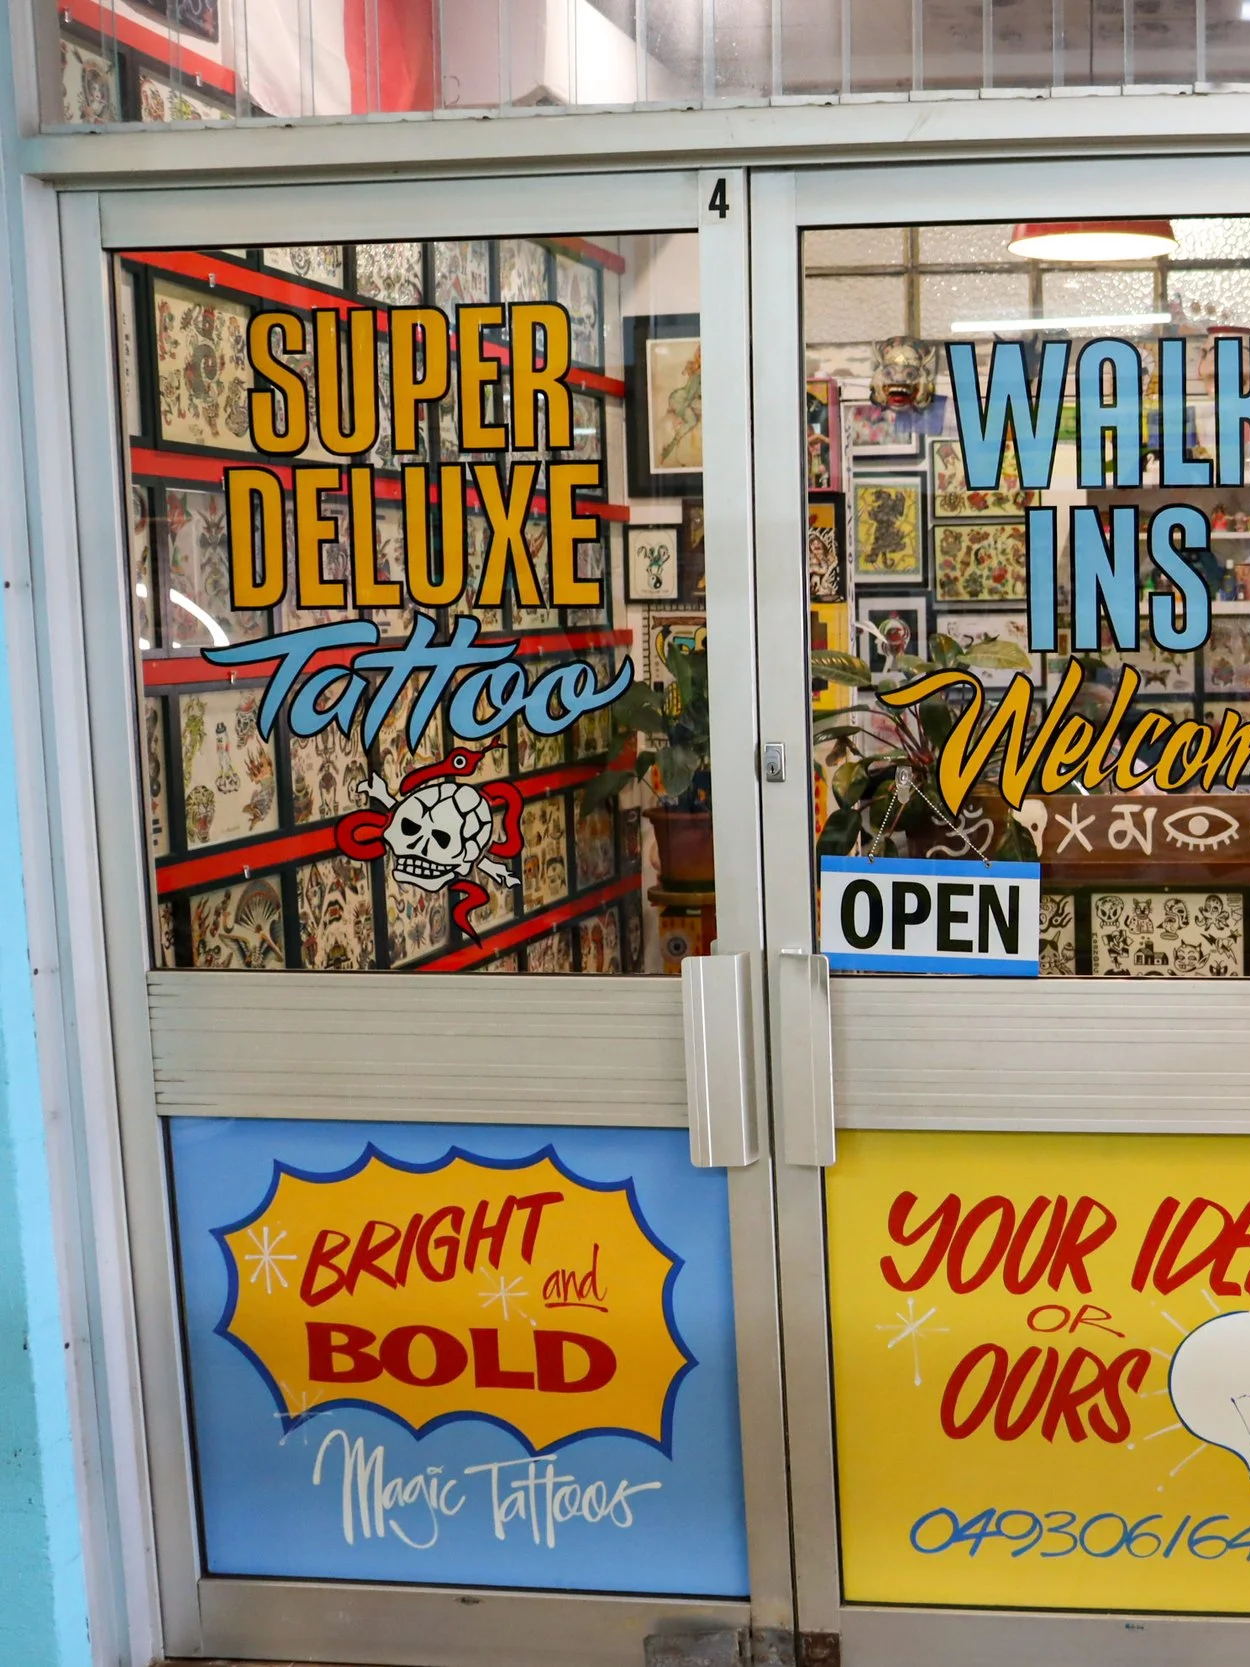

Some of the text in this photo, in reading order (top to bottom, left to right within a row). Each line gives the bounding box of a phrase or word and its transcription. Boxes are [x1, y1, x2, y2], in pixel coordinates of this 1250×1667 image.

[708, 178, 730, 219] 4
[247, 301, 574, 457] SUPER
[224, 461, 604, 612] DELUXE
[1025, 504, 1212, 653] INS
[200, 611, 634, 755] Tattoo
[840, 879, 1020, 955] OPEN
[300, 1192, 564, 1307] BRIGHT
[543, 1243, 608, 1304] and
[880, 1191, 1117, 1295] YOUR
[306, 1322, 617, 1393] BOLD
[1026, 1303, 1125, 1338] OR
[940, 1343, 1151, 1444] OURS
[313, 1429, 662, 1549] Magic Tattoos
